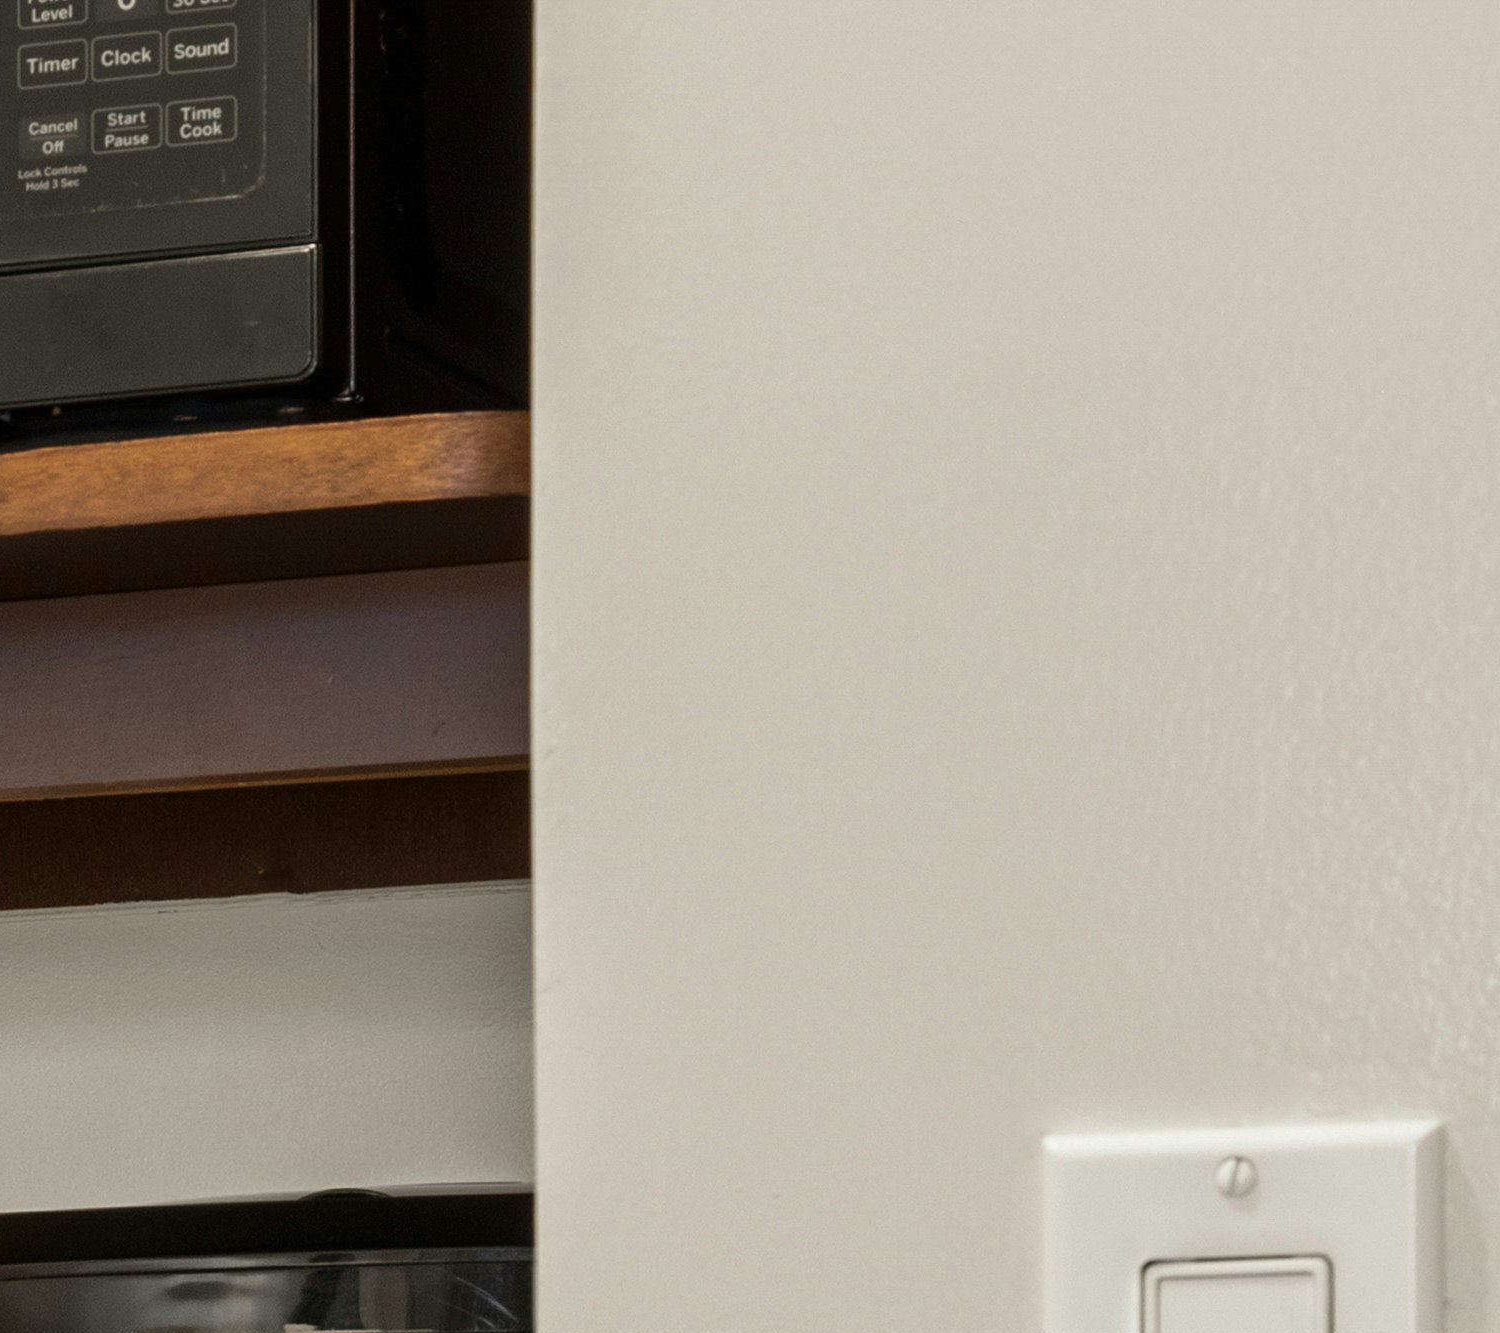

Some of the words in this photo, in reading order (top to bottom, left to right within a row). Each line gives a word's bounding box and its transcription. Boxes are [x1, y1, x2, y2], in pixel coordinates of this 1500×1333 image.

[31, 4, 73, 23] Level
[101, 47, 151, 67] Clock
[173, 37, 230, 60] Sound
[26, 56, 79, 74] Timer
[107, 110, 146, 127] Start
[180, 106, 222, 122] Time
[29, 118, 78, 136] Cancel
[180, 122, 222, 139] Cook
[42, 140, 65, 155] Off
[104, 133, 149, 148] Pause
[18, 169, 41, 180] Lock
[44, 164, 88, 177] Controls
[25, 180, 50, 192] Hold
[52, 179, 59, 190] 3
[61, 177, 80, 188] Sec
